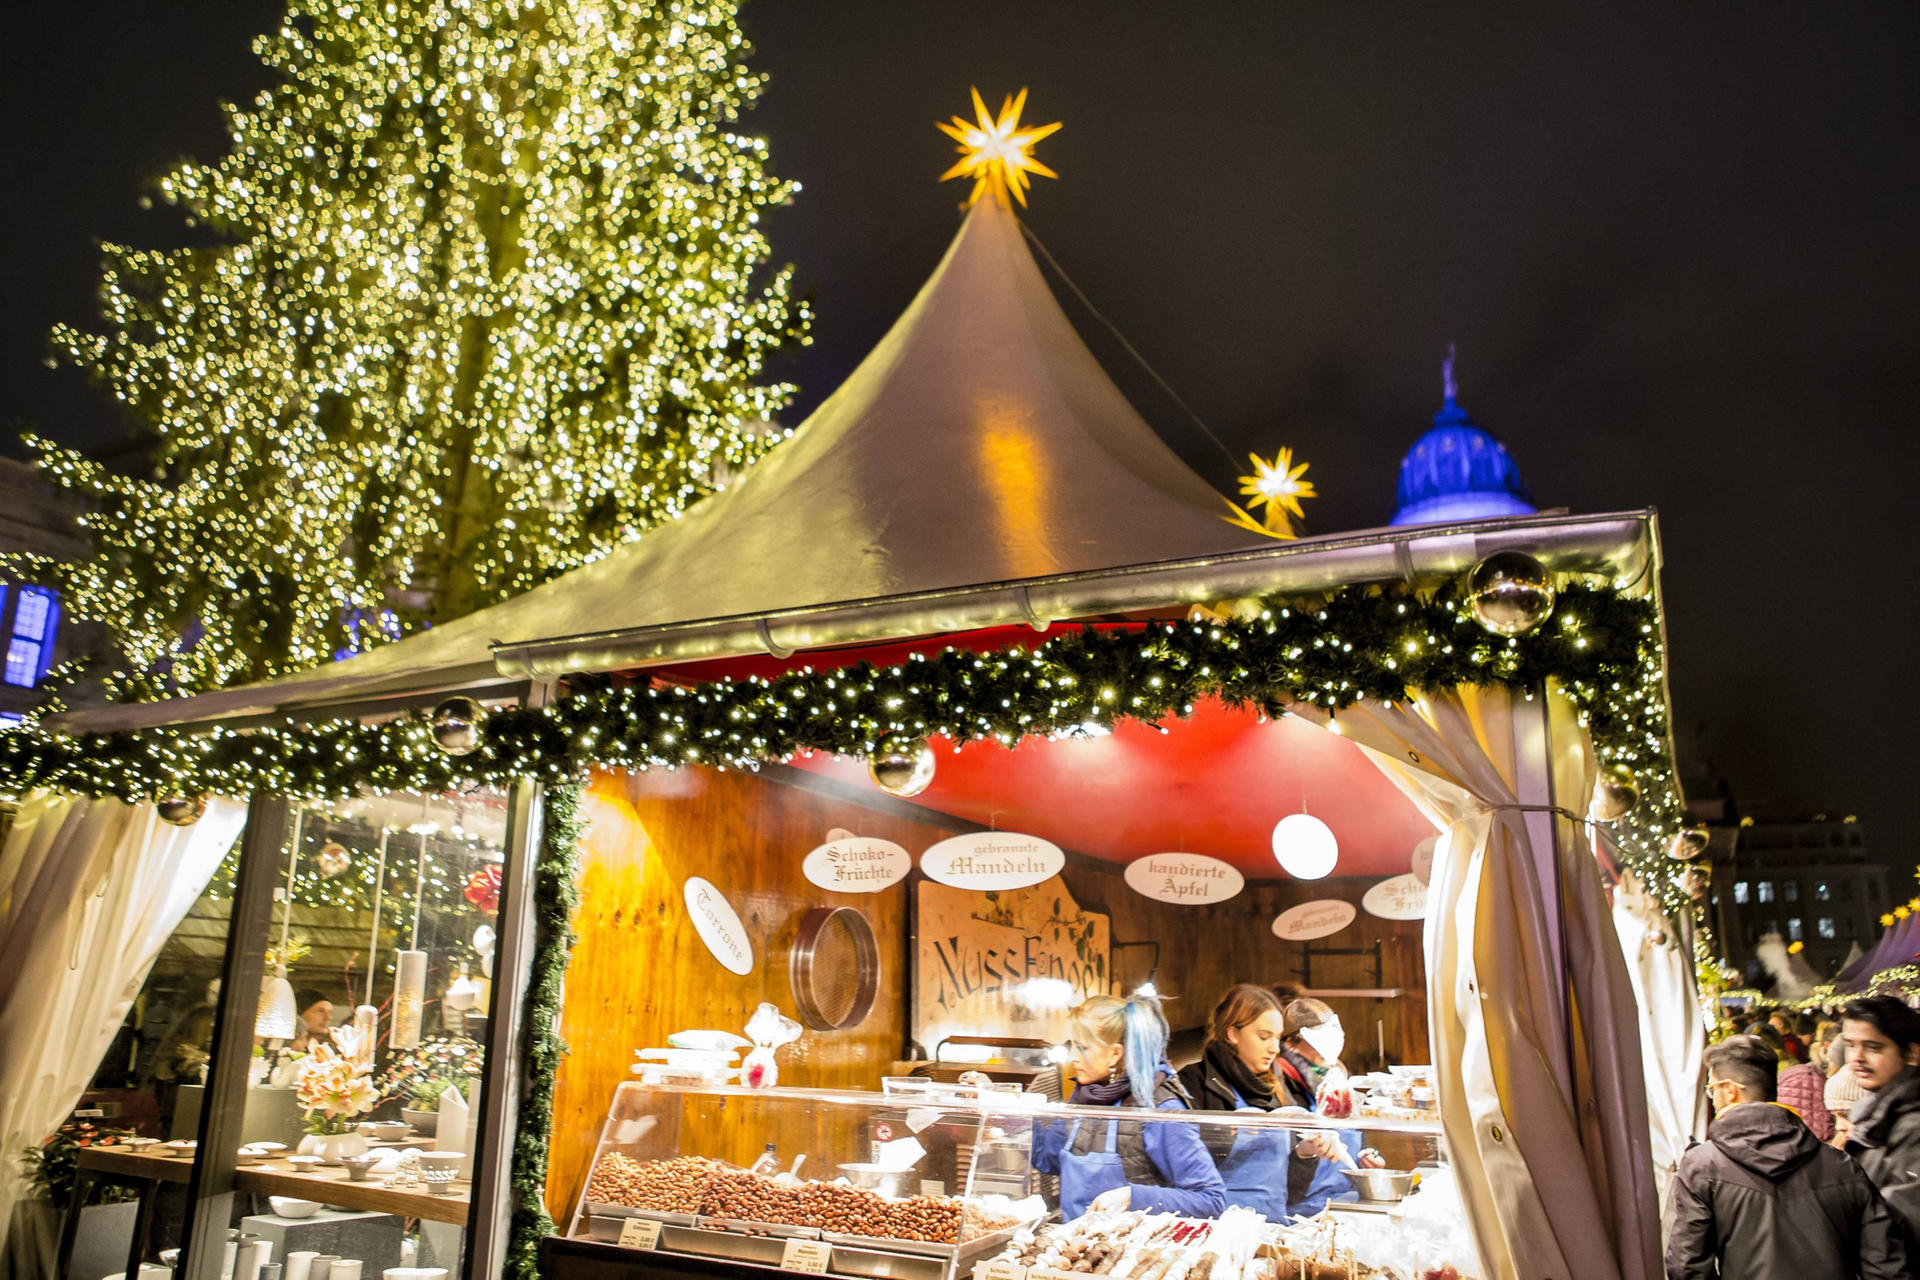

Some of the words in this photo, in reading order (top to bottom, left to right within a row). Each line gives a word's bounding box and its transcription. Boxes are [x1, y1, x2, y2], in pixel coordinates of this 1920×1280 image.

[825, 846, 894, 865] Schoko-
[974, 844, 1038, 856] gebrannte
[833, 865, 893, 882] Früchte
[945, 857, 1046, 875] Mandeln
[1148, 860, 1226, 878] kandierte
[1160, 875, 1208, 898] Äpfel
[697, 889, 743, 960] Torrone
